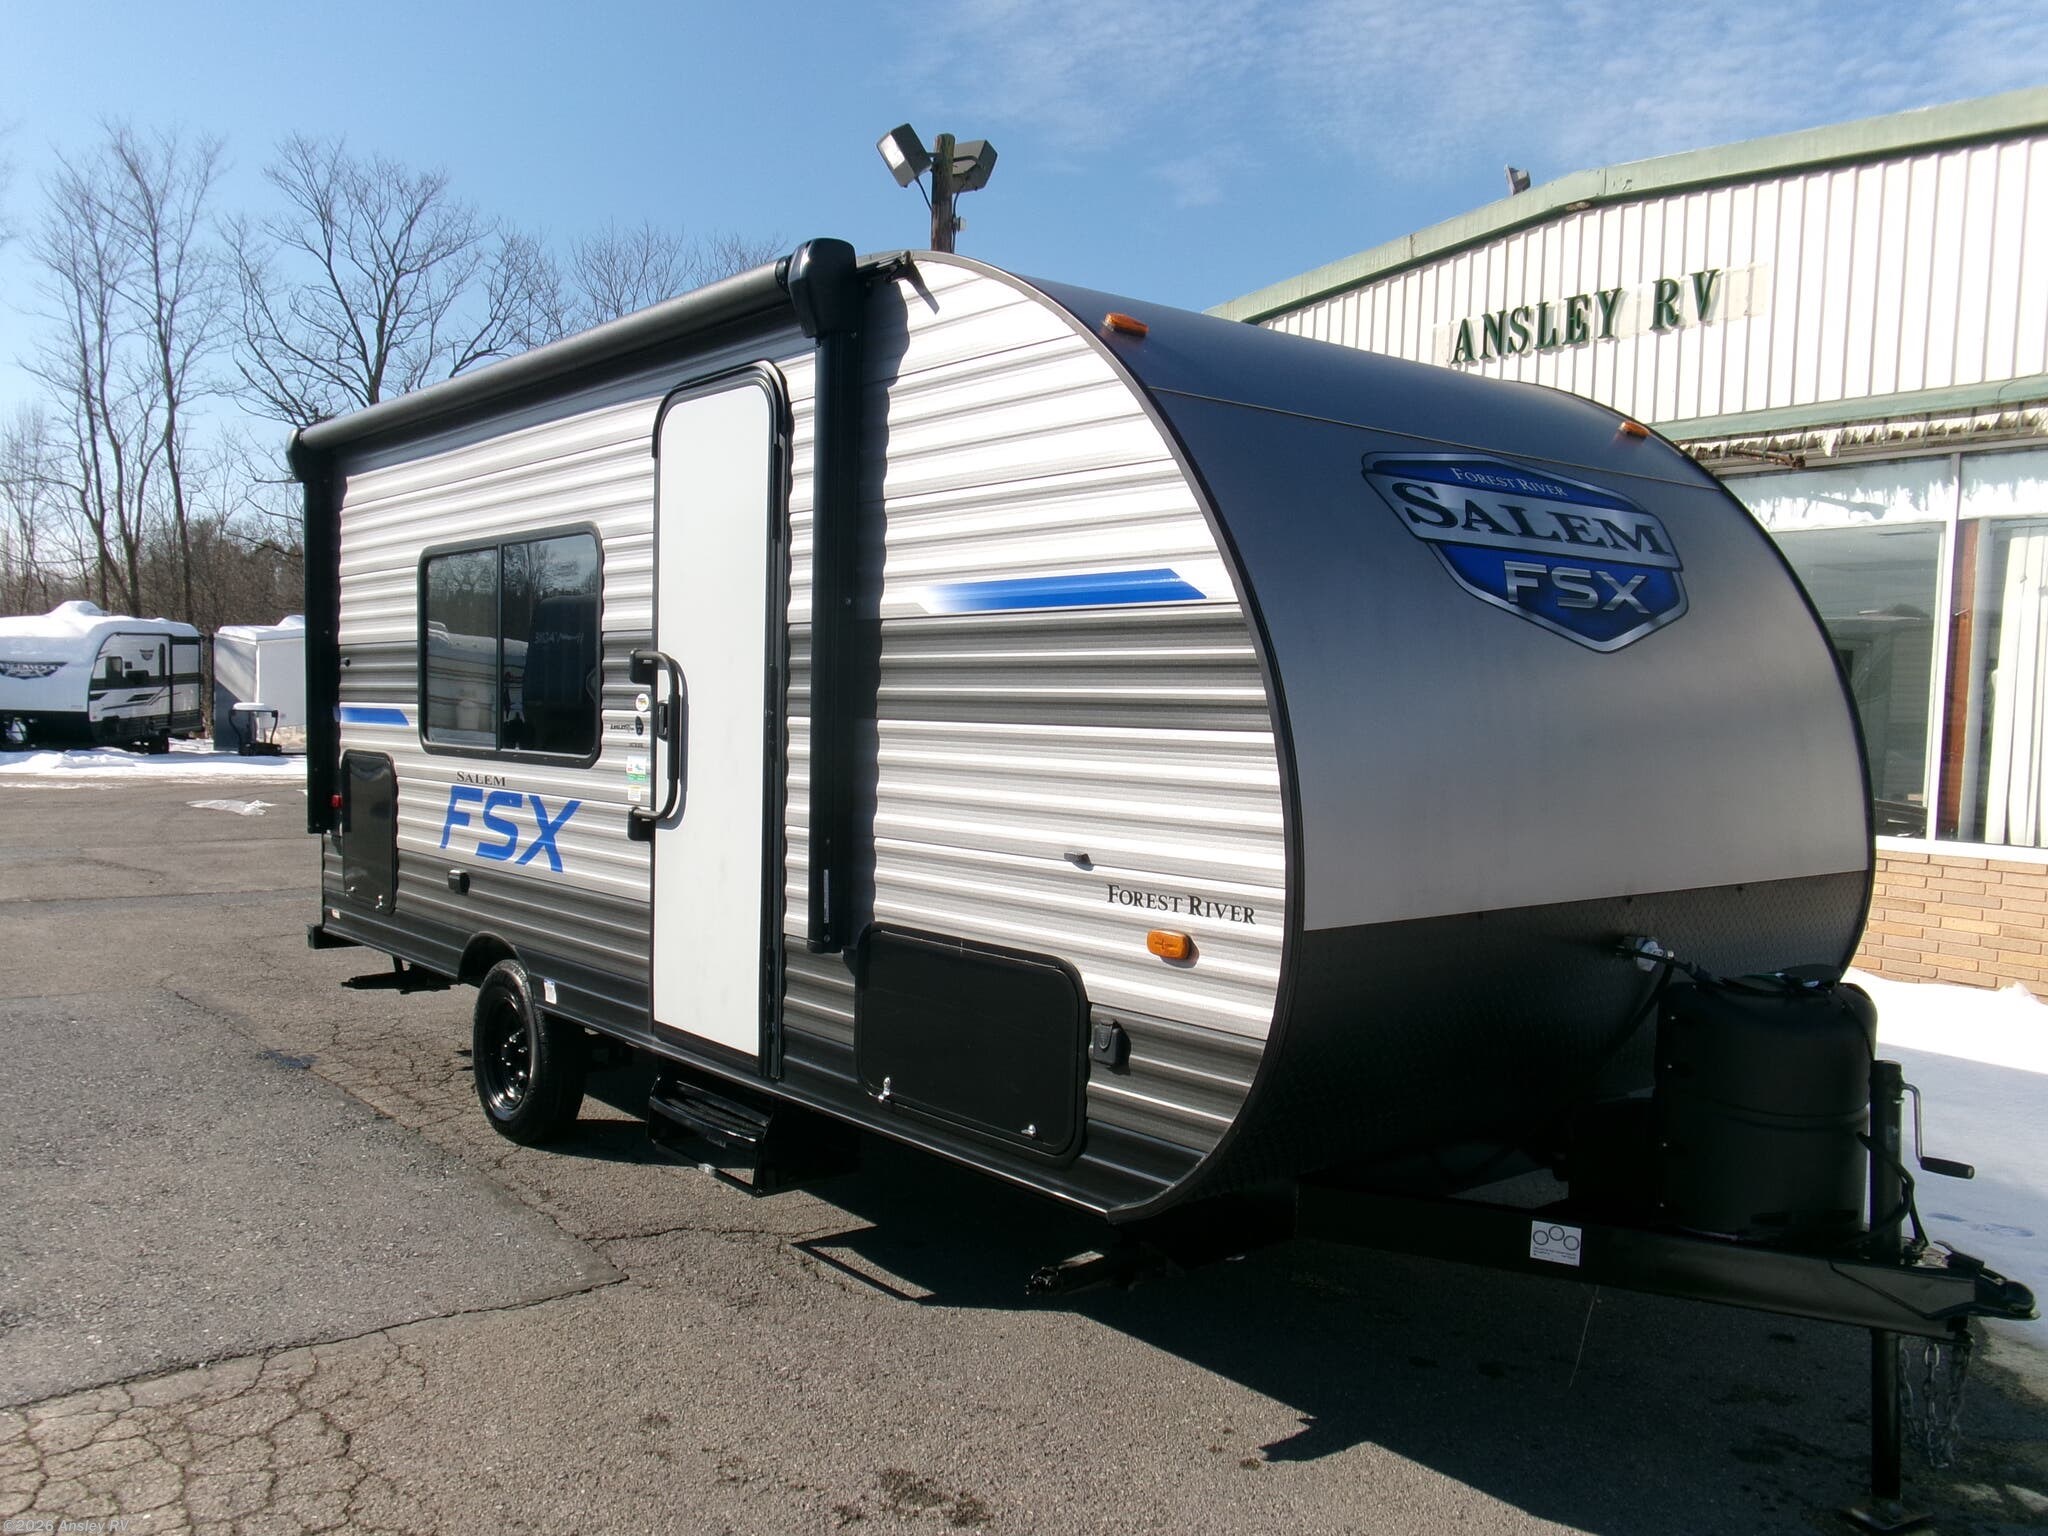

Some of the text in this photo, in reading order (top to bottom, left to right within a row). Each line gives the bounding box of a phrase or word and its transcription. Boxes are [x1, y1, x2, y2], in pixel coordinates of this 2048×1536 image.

[1450, 268, 1722, 365] ANSLEY RV
[1450, 467, 1568, 497] FOREST RIVER
[1391, 482, 1673, 557] SALEM
[1503, 560, 1651, 614] FSX
[456, 770, 506, 787] SALEM
[440, 785, 582, 873] FSX
[1106, 883, 1257, 925] FOREST RIVER
